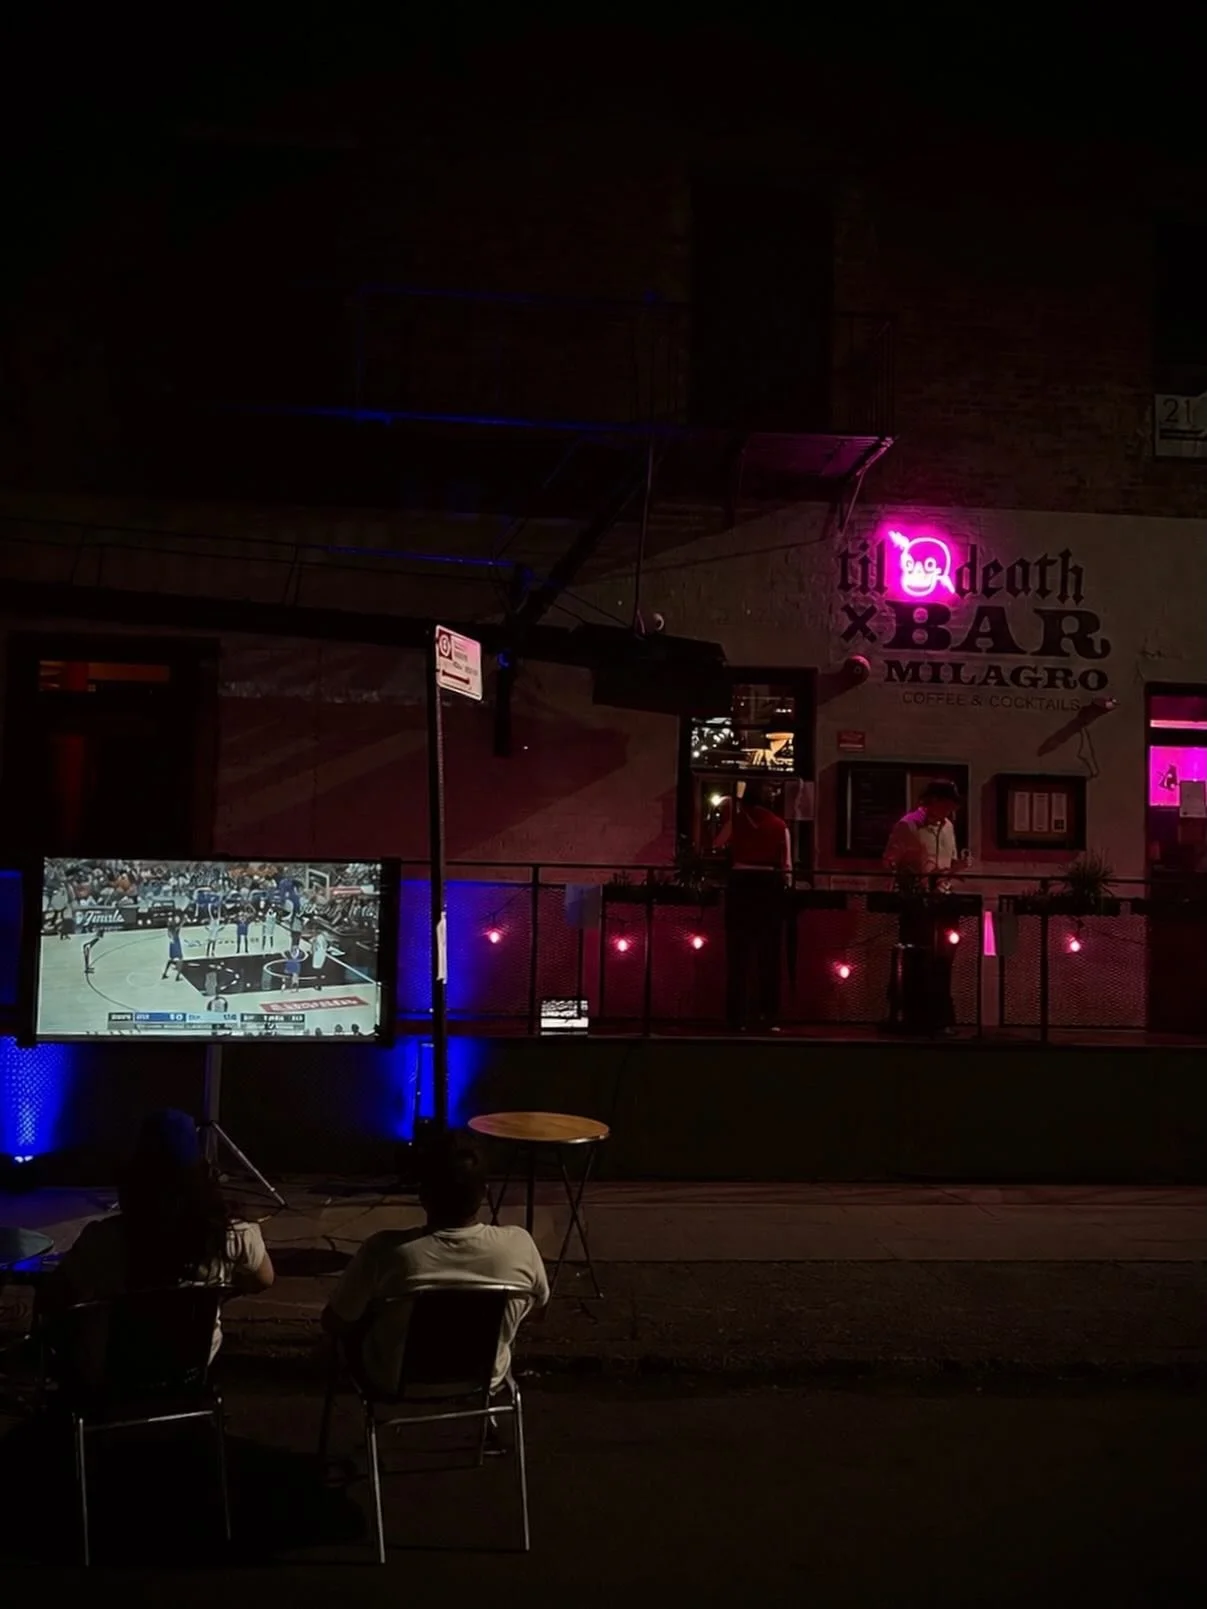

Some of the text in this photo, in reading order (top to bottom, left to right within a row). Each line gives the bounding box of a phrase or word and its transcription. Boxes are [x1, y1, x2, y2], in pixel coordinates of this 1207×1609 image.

[838, 541, 1085, 604] til death
[883, 602, 1111, 659] BAR
[885, 661, 1108, 691] MILAGRO
[902, 691, 1081, 713] COFFEE & COCKTAILS
